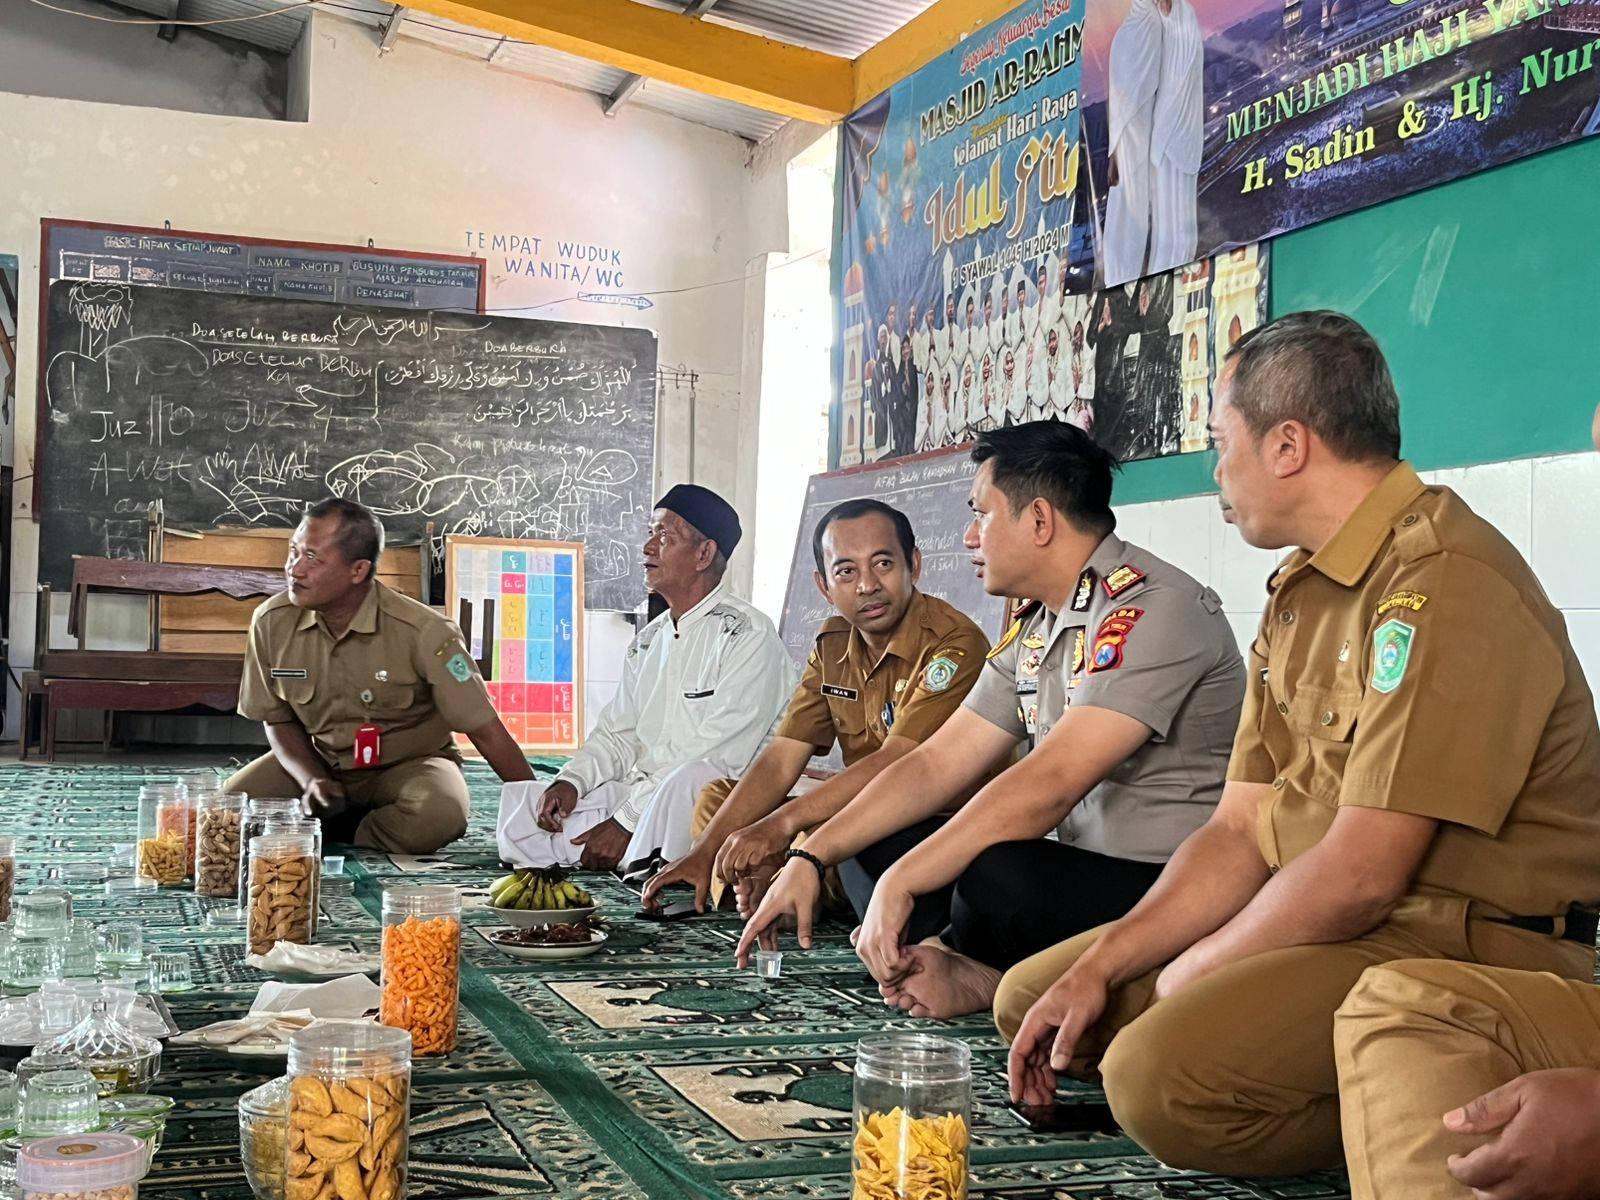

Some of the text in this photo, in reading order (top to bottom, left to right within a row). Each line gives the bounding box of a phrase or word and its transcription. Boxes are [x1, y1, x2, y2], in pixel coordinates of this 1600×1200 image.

[1225, 53, 1370, 143] MENJADI
[1380, 9, 1473, 79] HAJI
[920, 77, 986, 146] MASJID
[953, 126, 1001, 168] Selamat
[1007, 103, 1037, 142] Hari
[1041, 89, 1077, 126] Raya
[1241, 157, 1273, 193] H.
[1285, 125, 1376, 180] Sadin
[1397, 100, 1427, 139] &
[1449, 70, 1504, 122] Hj.
[924, 153, 1007, 256] Idul
[258, 257, 291, 268] NAMA
[465, 231, 621, 266] TEMPAT WUDUK
[960, 251, 1000, 286] SYAWAL
[1033, 230, 1058, 256] 2024
[90, 411, 142, 442] Juz
[829, 687, 849, 697] IWAN
